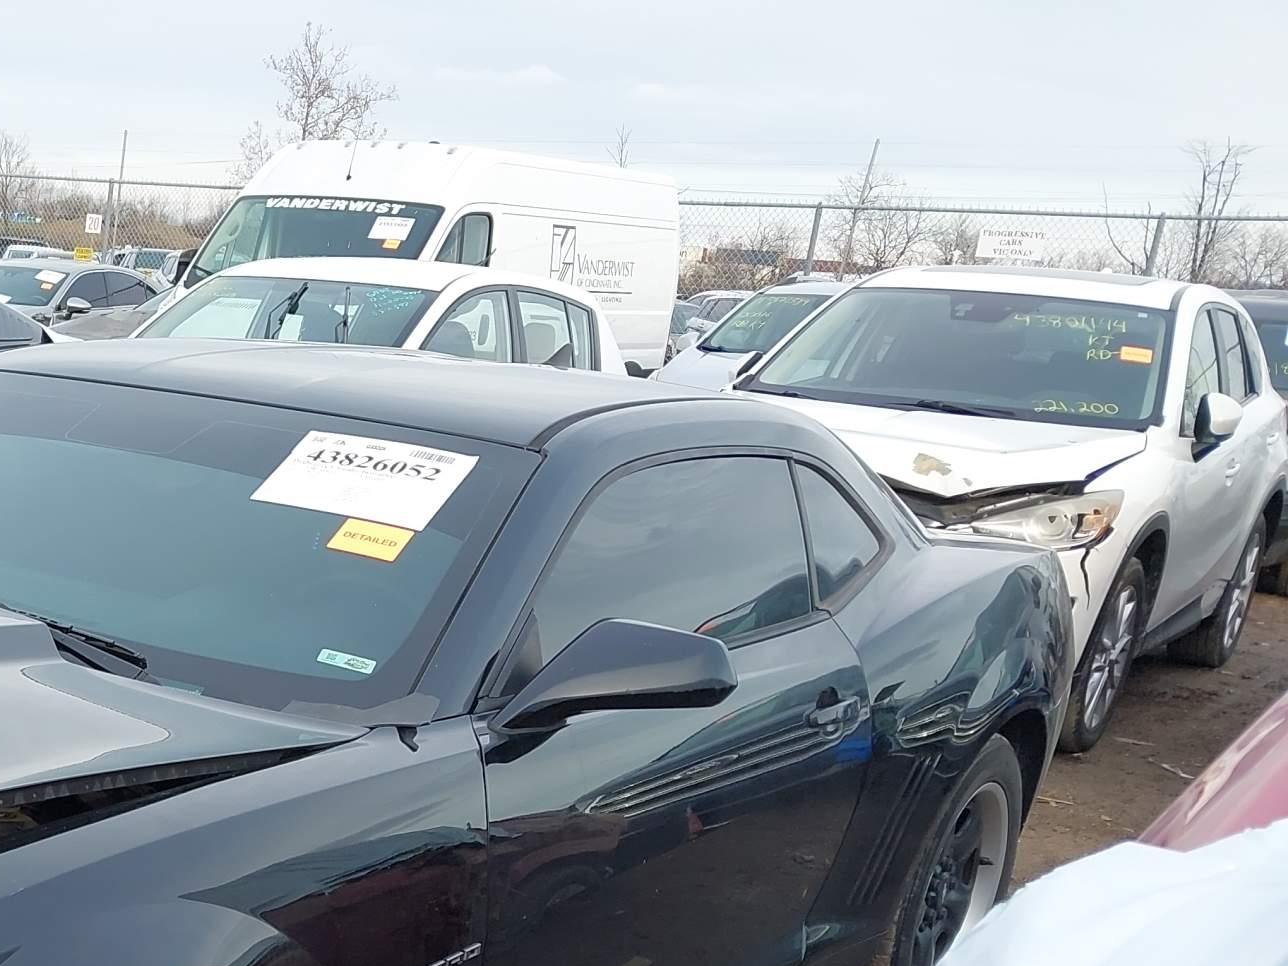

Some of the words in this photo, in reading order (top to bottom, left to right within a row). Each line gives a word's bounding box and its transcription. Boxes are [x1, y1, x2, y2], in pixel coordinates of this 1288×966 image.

[265, 197, 406, 215] VANDERWIST
[983, 229, 1047, 240] PROGRESSIVE
[577, 252, 636, 278] VANDERWIST
[306, 448, 442, 481] 43826052
[343, 531, 398, 547] DETAILED
